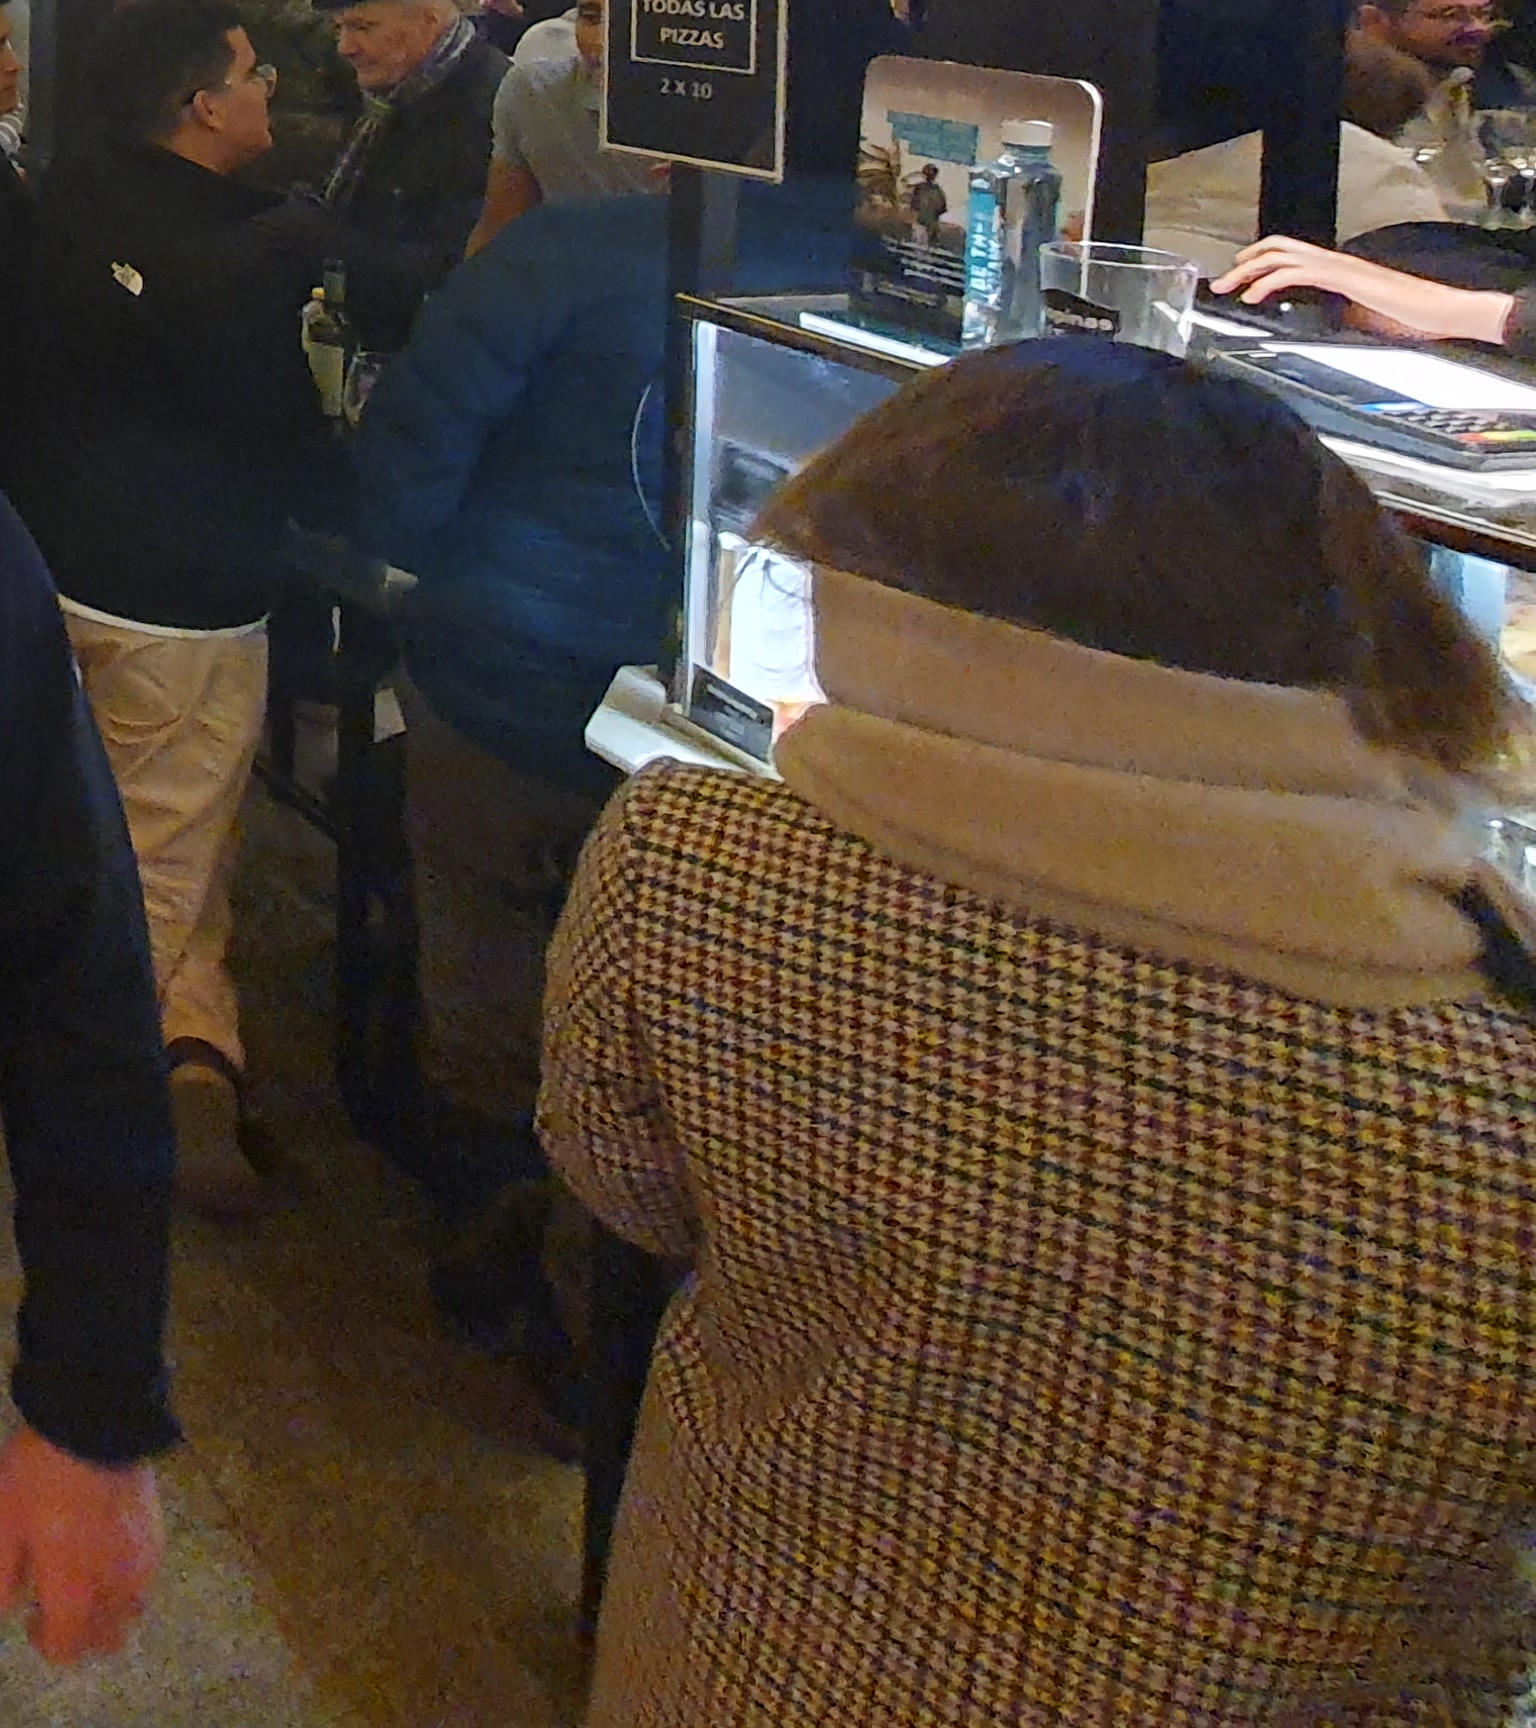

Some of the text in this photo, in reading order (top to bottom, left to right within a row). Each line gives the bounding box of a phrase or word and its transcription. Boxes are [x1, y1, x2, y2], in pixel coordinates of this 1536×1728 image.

[709, 2, 745, 21] LAS
[659, 26, 725, 50] PIZZAS
[659, 77, 670, 94] 2
[691, 81, 714, 100] 10
